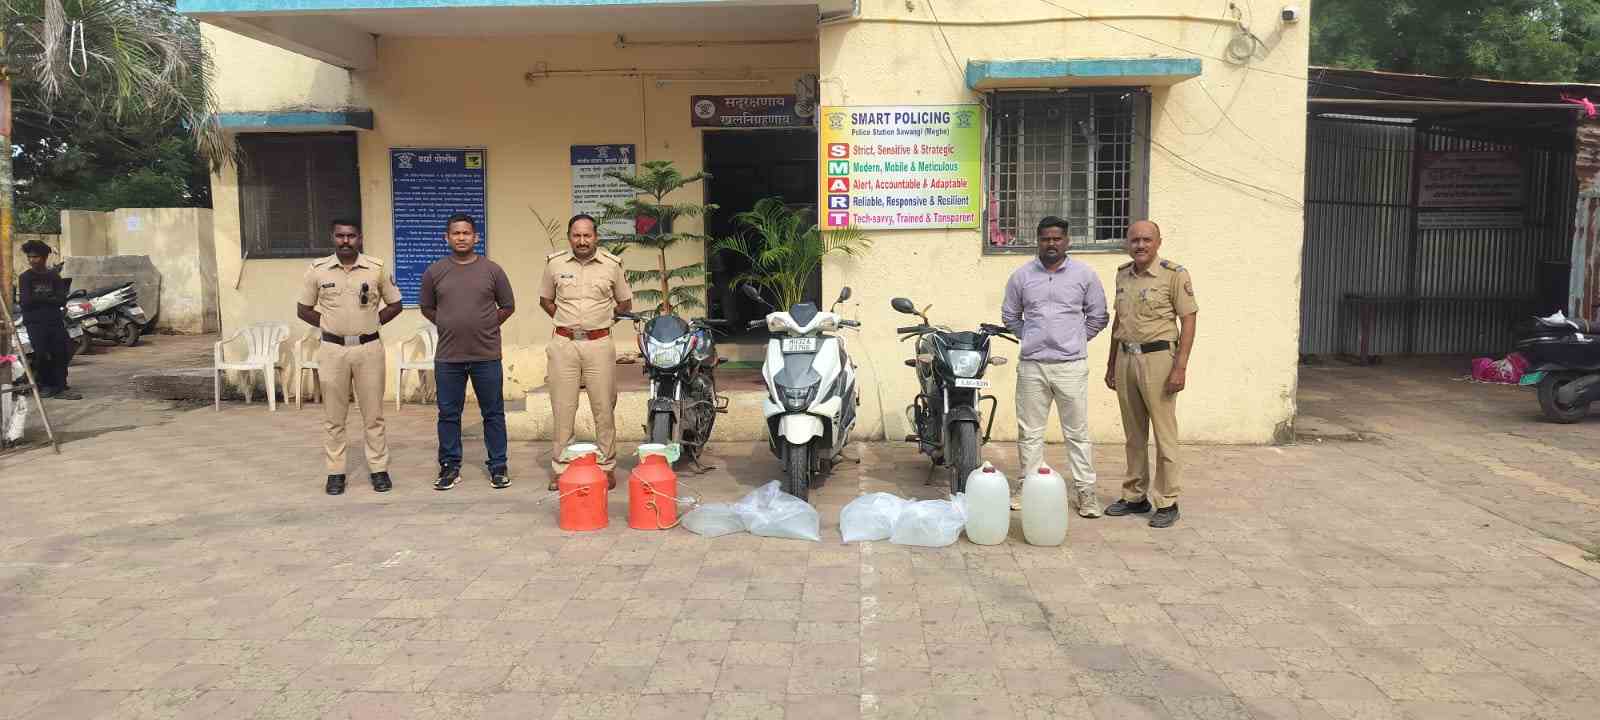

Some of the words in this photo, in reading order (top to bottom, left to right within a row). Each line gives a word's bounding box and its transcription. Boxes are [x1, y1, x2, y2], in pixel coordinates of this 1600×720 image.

[851, 112, 891, 125] SMART
[894, 111, 951, 124] POLICING
[851, 128, 871, 136] Police
[873, 128, 895, 136] Station
[831, 145, 847, 156] S
[852, 145, 875, 156] Strict,
[877, 145, 911, 155] Sensitive
[914, 145, 919, 154] &
[921, 144, 955, 157] Strategic
[830, 161, 849, 174] M
[853, 161, 883, 173] Modern,
[884, 161, 908, 172] Mobile
[910, 161, 916, 172] &
[920, 161, 958, 172] Meticulous
[830, 179, 848, 191] A
[853, 179, 873, 191] Alert,
[876, 179, 921, 190] Accountable
[923, 179, 928, 189] &
[931, 178, 967, 190] Adaptable
[830, 196, 849, 208] R
[853, 196, 885, 207] Reliable,
[886, 195, 927, 208] Responsive
[929, 196, 935, 206] &
[938, 195, 969, 206] Resilient
[831, 213, 847, 225] T
[853, 214, 895, 225] Tech-savvy,
[896, 213, 924, 223] Trained
[926, 213, 931, 222] &
